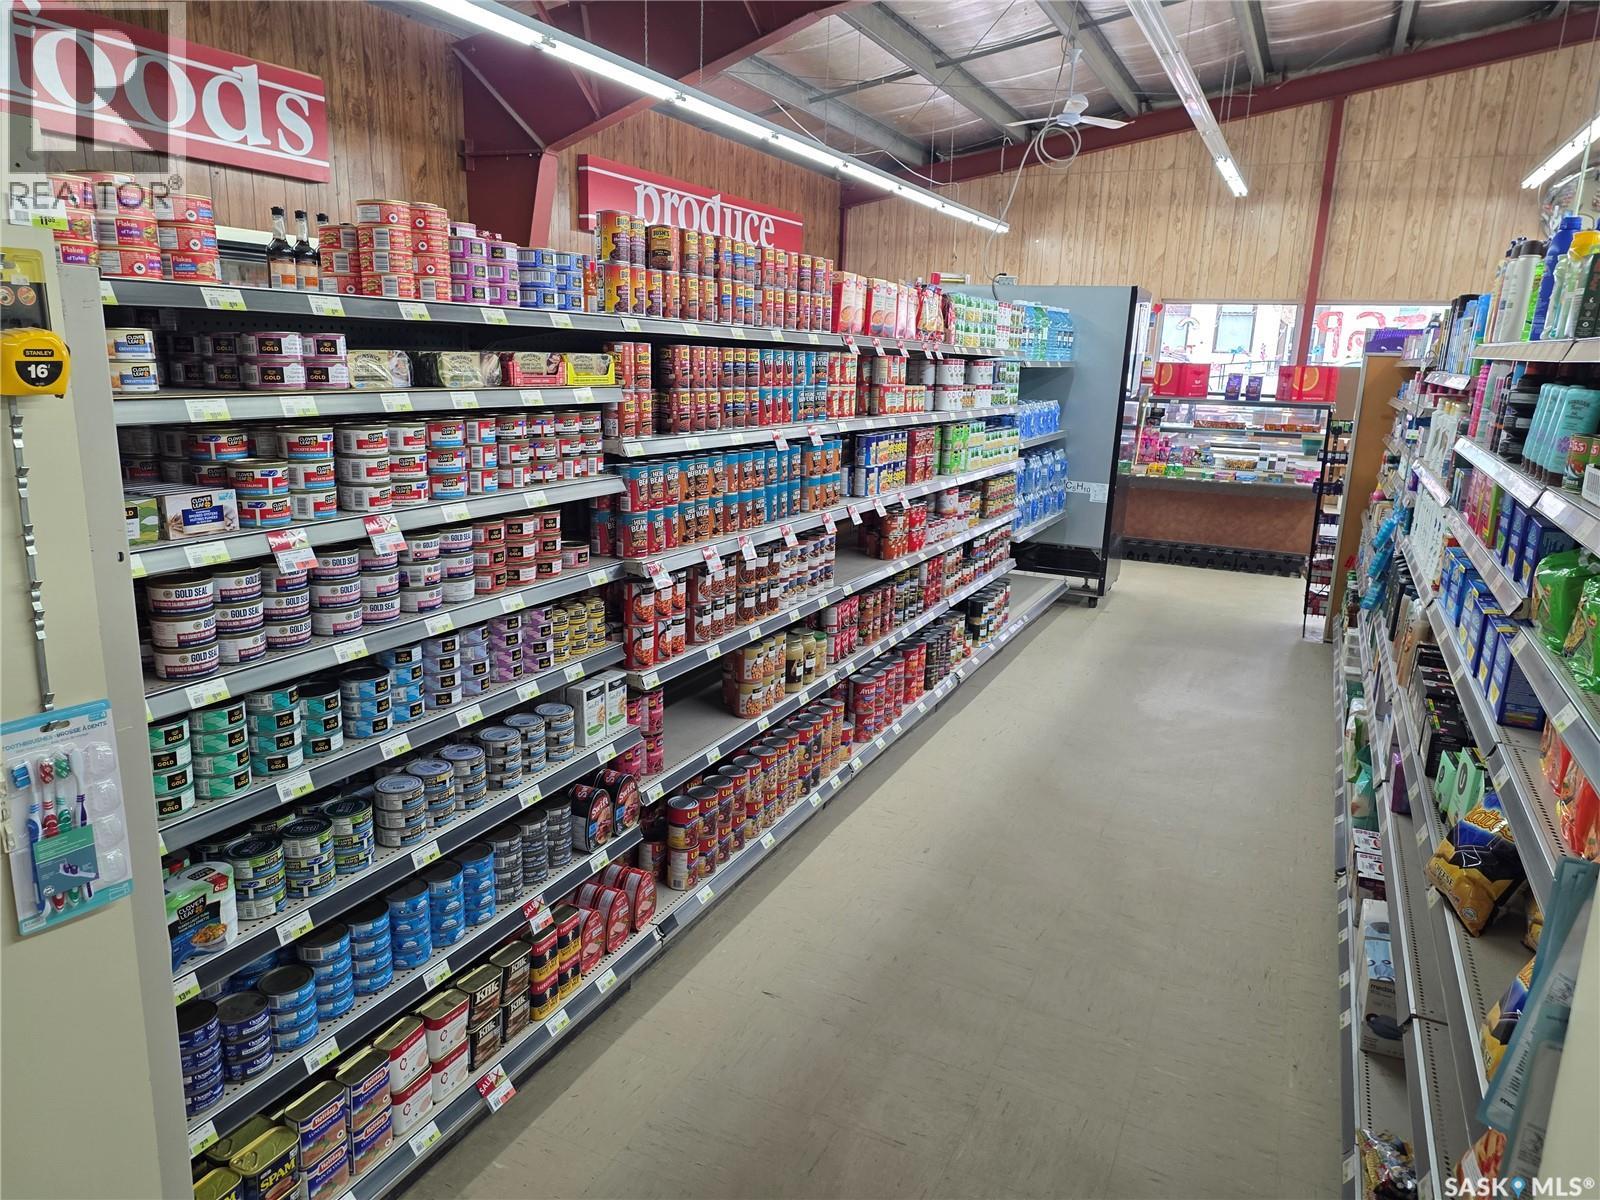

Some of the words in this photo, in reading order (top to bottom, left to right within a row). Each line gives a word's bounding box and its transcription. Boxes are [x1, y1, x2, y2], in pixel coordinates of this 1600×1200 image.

[634, 183, 775, 248] produce
[63, 246, 84, 254] Flakes
[332, 557, 346, 566] GOLD
[347, 556, 356, 564] SEAL
[175, 590, 193, 599] GOLD
[195, 586, 208, 596] SEAL
[340, 585, 353, 594] GOLD
[286, 598, 299, 606] GOLD
[385, 602, 395, 610] SEAL
[231, 609, 247, 618] GOLD
[248, 607, 260, 616] SEAL
[289, 625, 303, 634] GOLD
[191, 654, 207, 663] GOLD
[231, 713, 243, 721] GOLD
[280, 719, 292, 727] GOLD
[327, 721, 337, 729] GOLD
[168, 733, 183, 742] GOLD
[231, 736, 244, 744] GOLD
[280, 739, 293, 747] GOLD
[158, 760, 174, 768] GOLD
[171, 778, 186, 787] GOLD
[618, 782, 636, 803] Swift
[163, 804, 179, 812] GOLD
[591, 797, 609, 818] Swift
[178, 897, 204, 915] CLOVER
[180, 909, 194, 920] LEAF
[365, 1068, 386, 1089] Holiday
[315, 1104, 338, 1125] Holiday
[366, 1113, 387, 1134] Holiday
[320, 1149, 344, 1172] Holiday
[260, 1158, 296, 1190] SPAM
